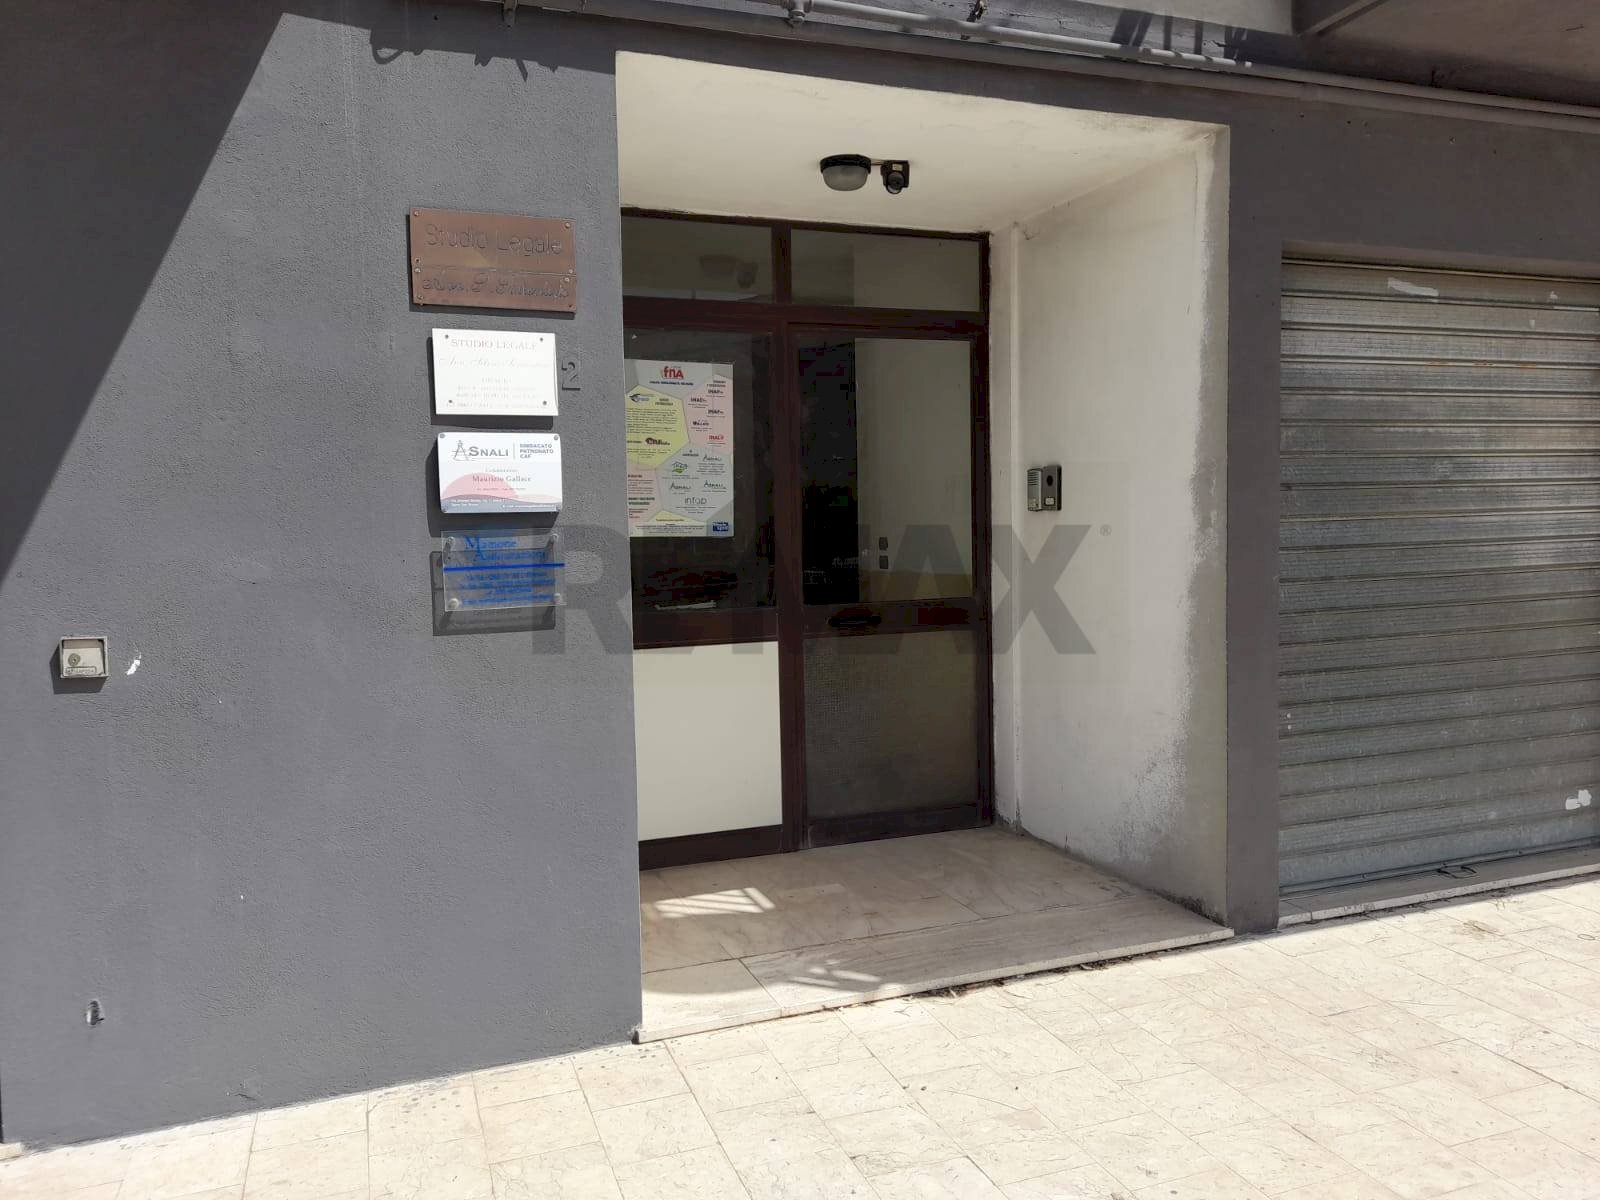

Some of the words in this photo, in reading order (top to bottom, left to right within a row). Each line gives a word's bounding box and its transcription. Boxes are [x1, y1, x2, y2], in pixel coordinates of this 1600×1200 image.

[425, 223, 489, 248] Studio
[497, 229, 562, 256] Legale
[450, 338, 494, 349] STUDIO
[472, 474, 504, 482] Maurizio
